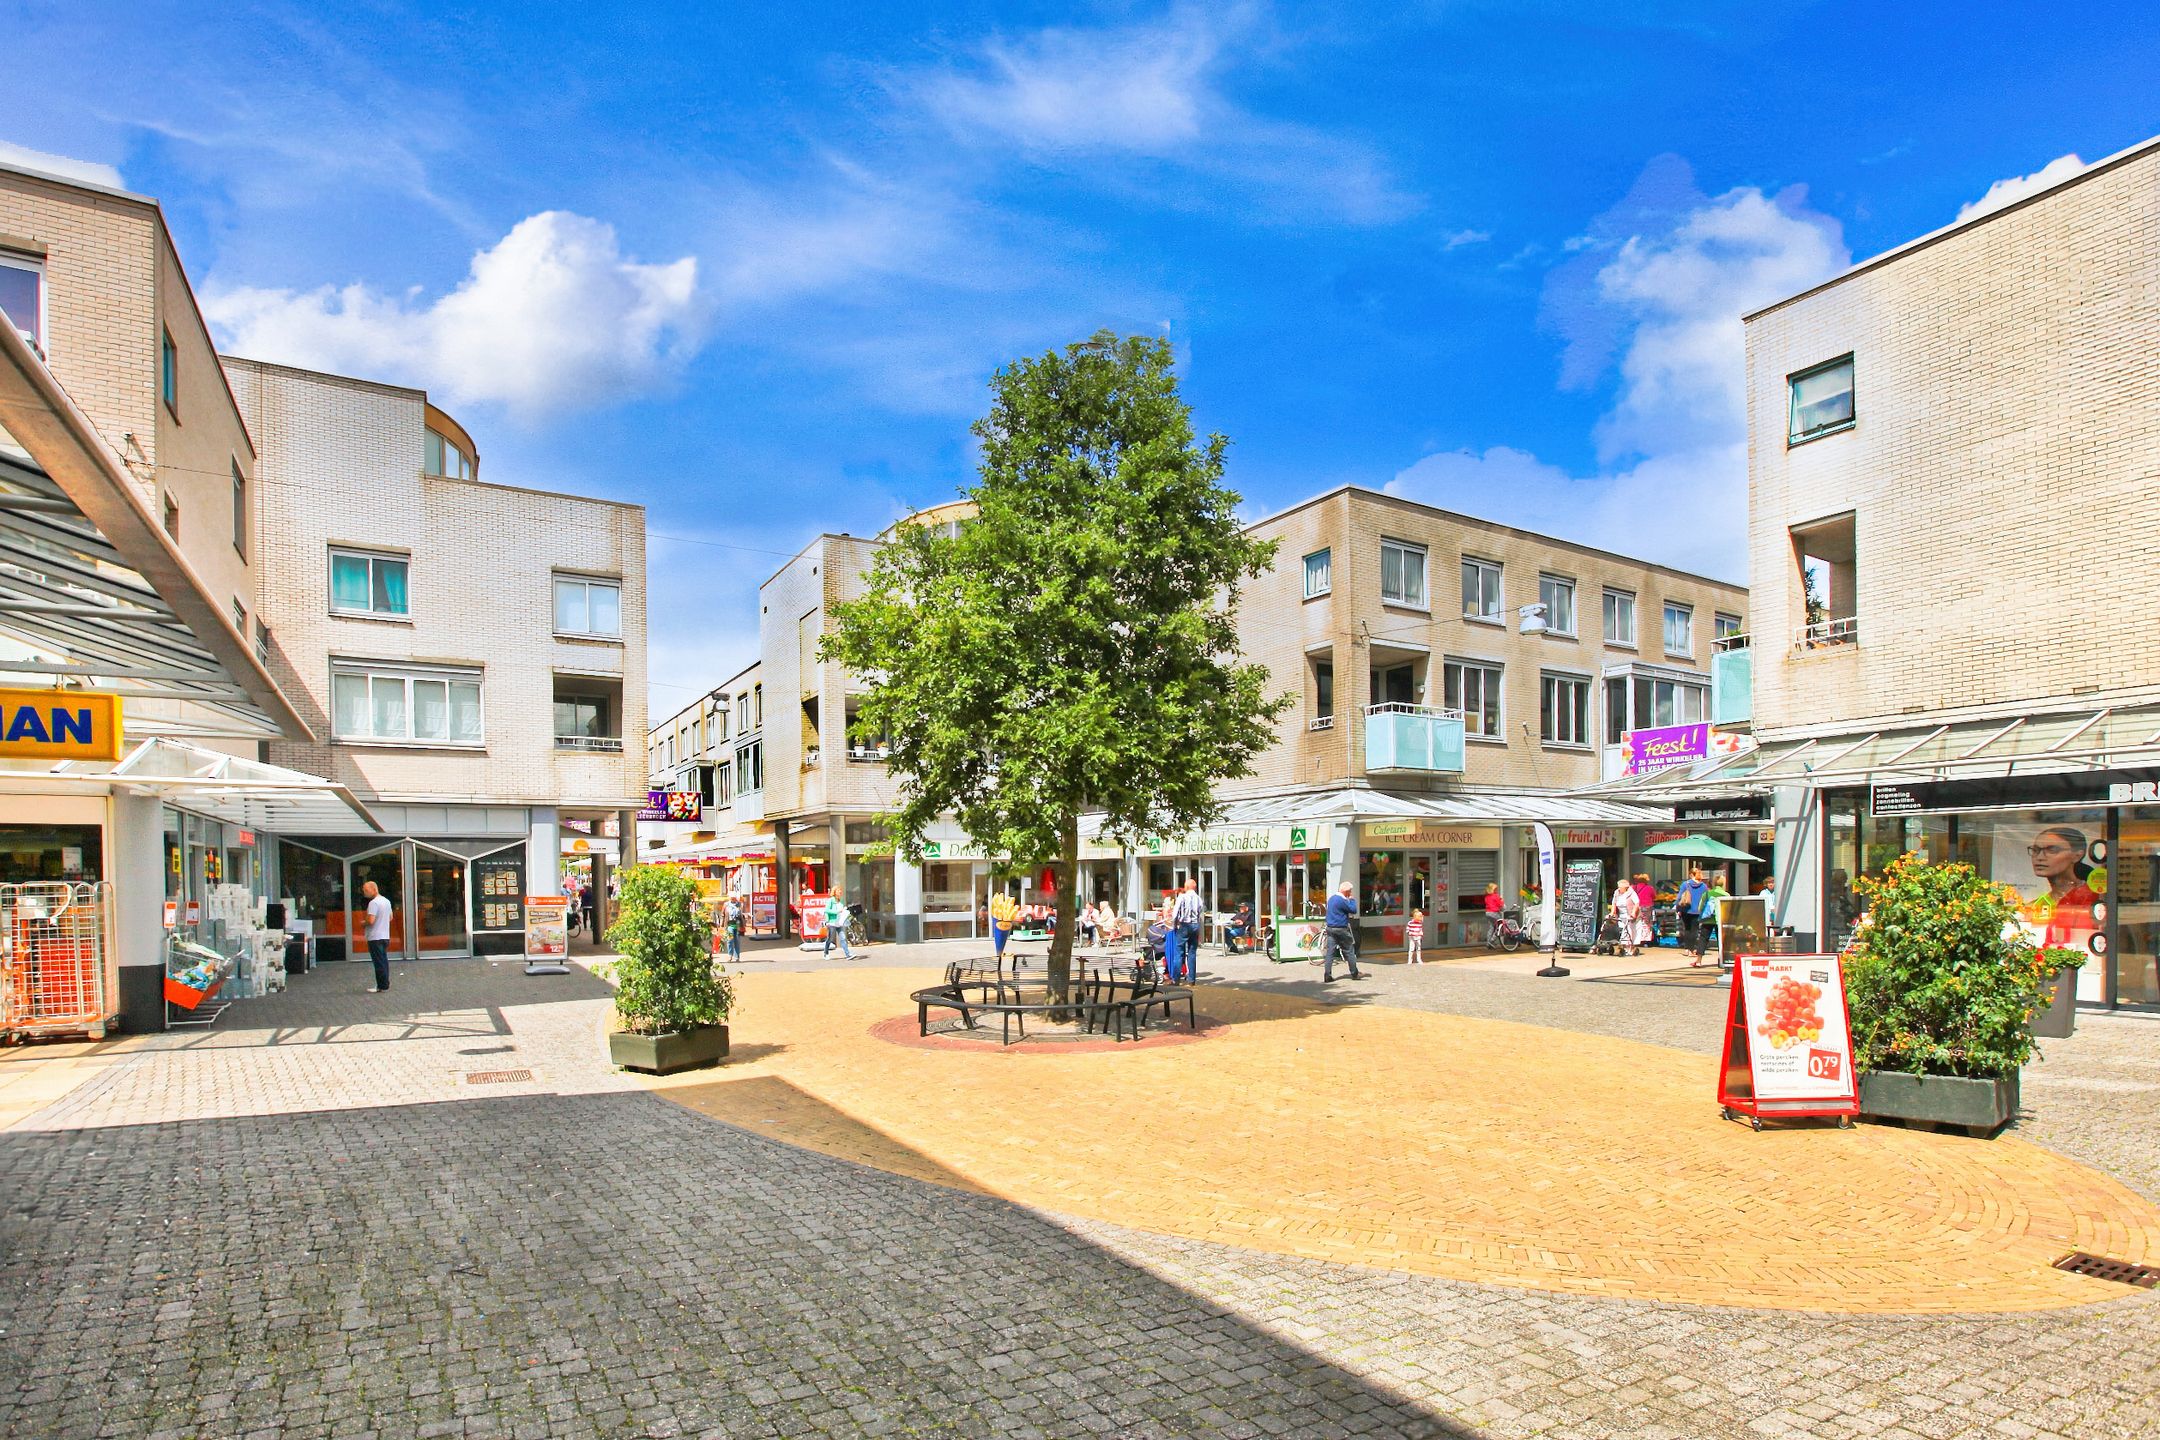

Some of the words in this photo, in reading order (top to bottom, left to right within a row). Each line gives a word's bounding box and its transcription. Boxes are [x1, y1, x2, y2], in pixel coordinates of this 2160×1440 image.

[0, 705, 93, 744] AN
[1642, 728, 1698, 757] Feest!
[1648, 757, 1666, 766] JAAR
[2109, 781, 2160, 802] BR
[1227, 832, 1270, 851] Snacks
[1437, 832, 1473, 844] CORNER
